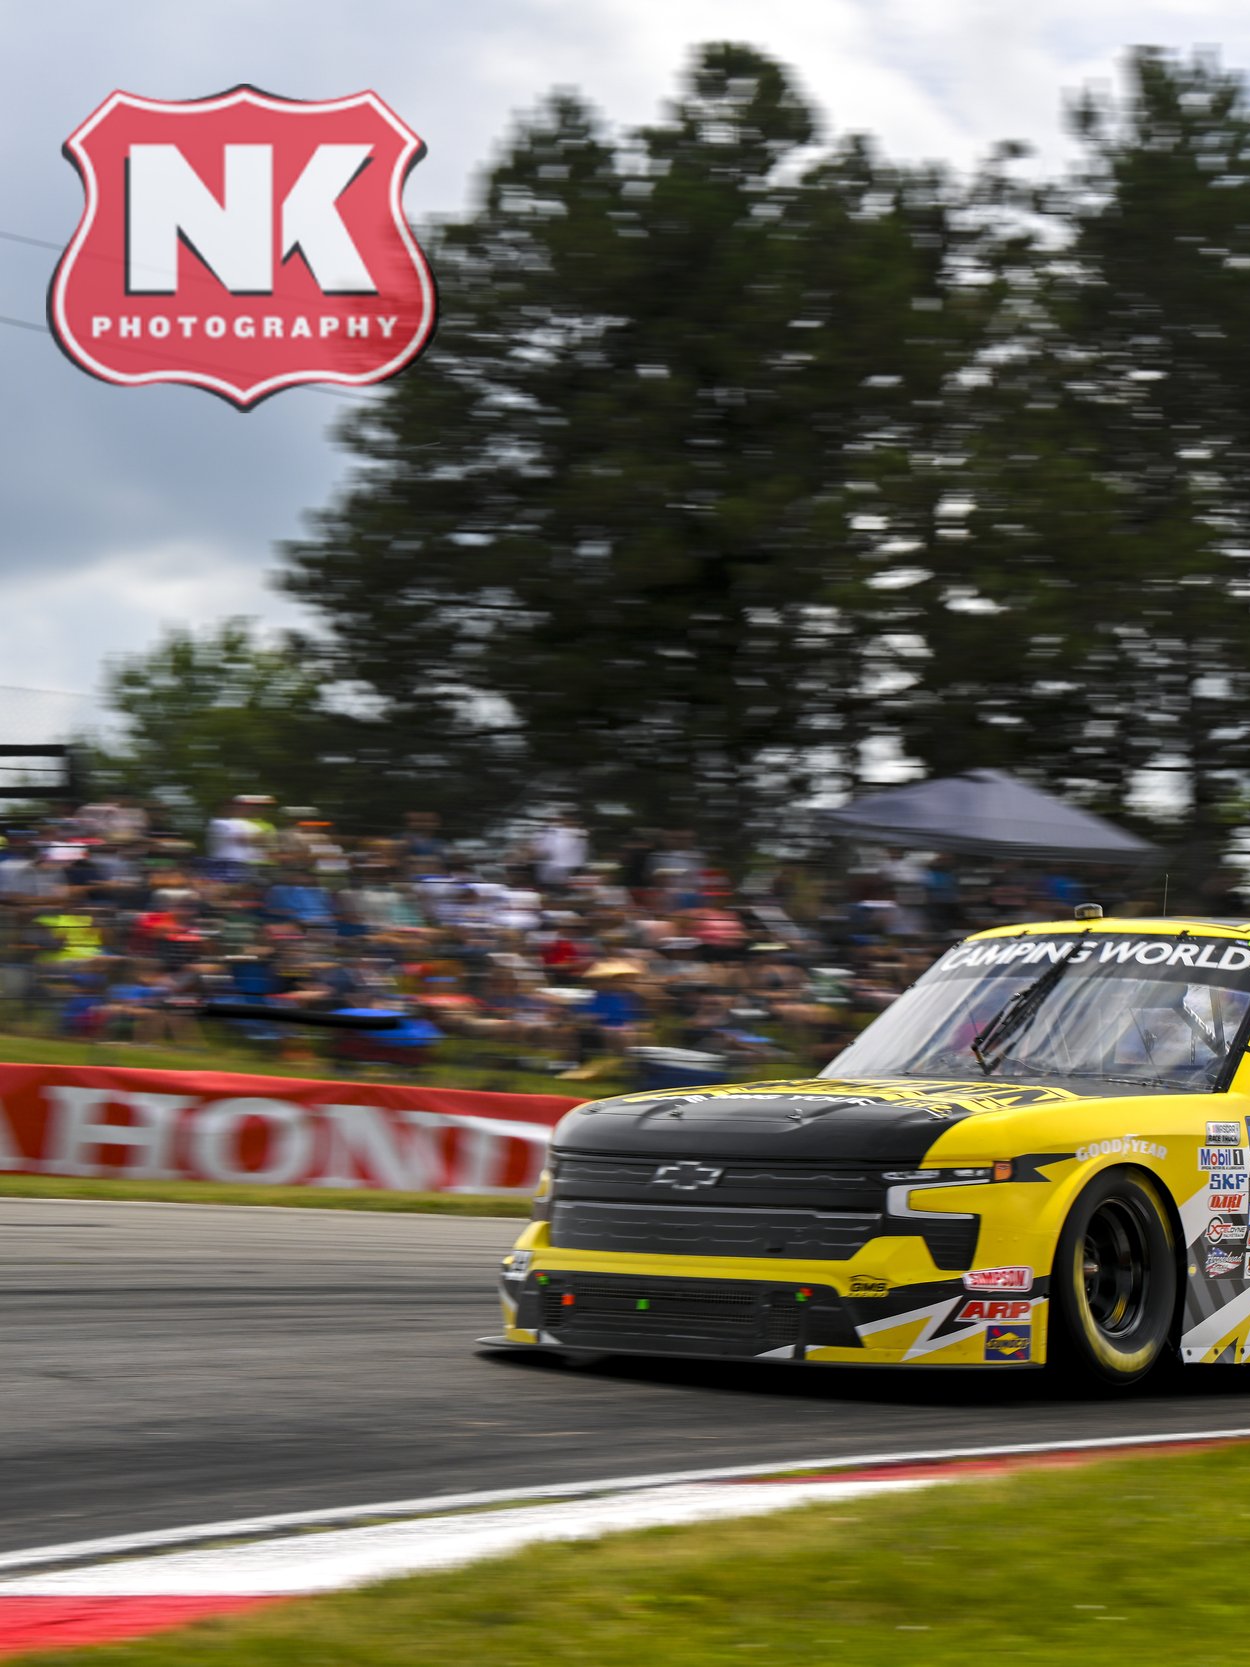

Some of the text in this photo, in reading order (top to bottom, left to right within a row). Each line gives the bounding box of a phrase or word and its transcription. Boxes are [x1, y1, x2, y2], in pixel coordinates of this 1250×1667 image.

[941, 941, 1098, 971] CAMPING
[40, 1085, 553, 1195] HOND
[1076, 1137, 1168, 1162] GOODYEAR
[1200, 1148, 1232, 1166] Mobil
[1209, 1174, 1248, 1190] SKF
[969, 1270, 1026, 1287] SIMPSON
[960, 1302, 1031, 1318] ARP
[986, 1338, 1031, 1350] SUNOCO
